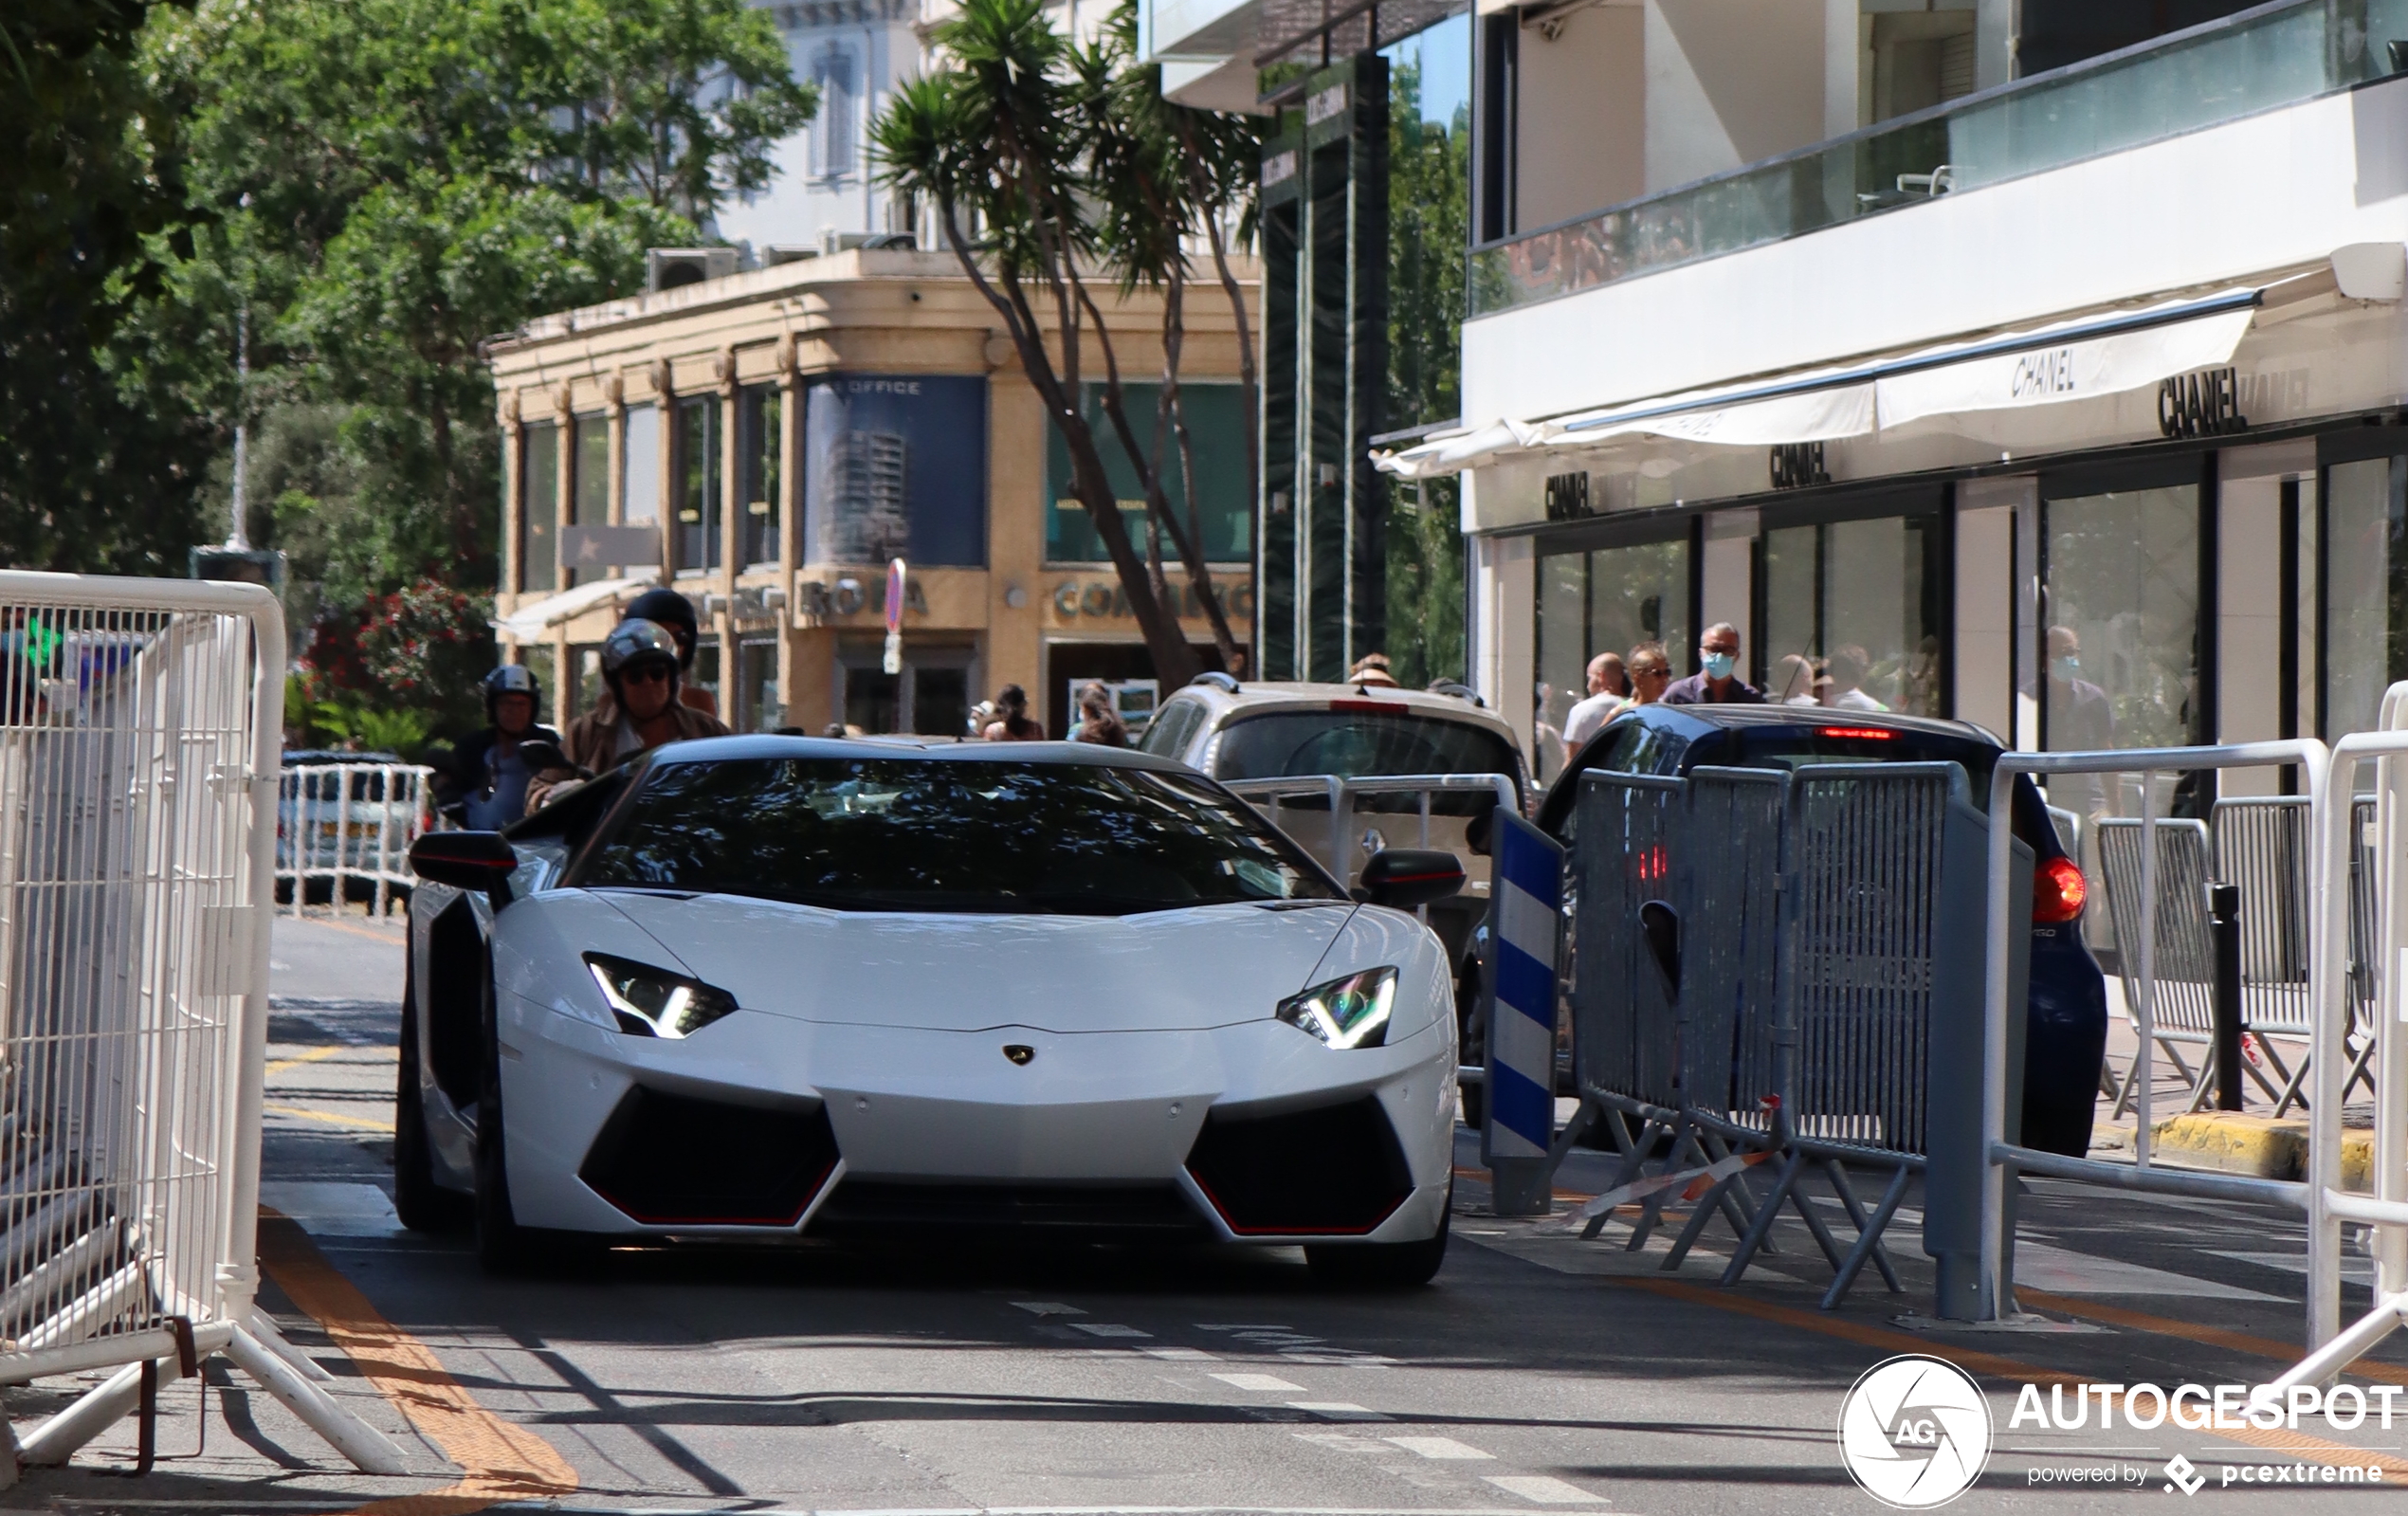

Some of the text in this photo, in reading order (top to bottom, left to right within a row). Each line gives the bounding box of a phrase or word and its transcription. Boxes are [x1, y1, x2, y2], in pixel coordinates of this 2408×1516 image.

[848, 380, 921, 395] OFFICE
[2011, 348, 2074, 398] CHANEL
[2157, 366, 2248, 438] CHANEL
[1770, 442, 1832, 487] CHANEL
